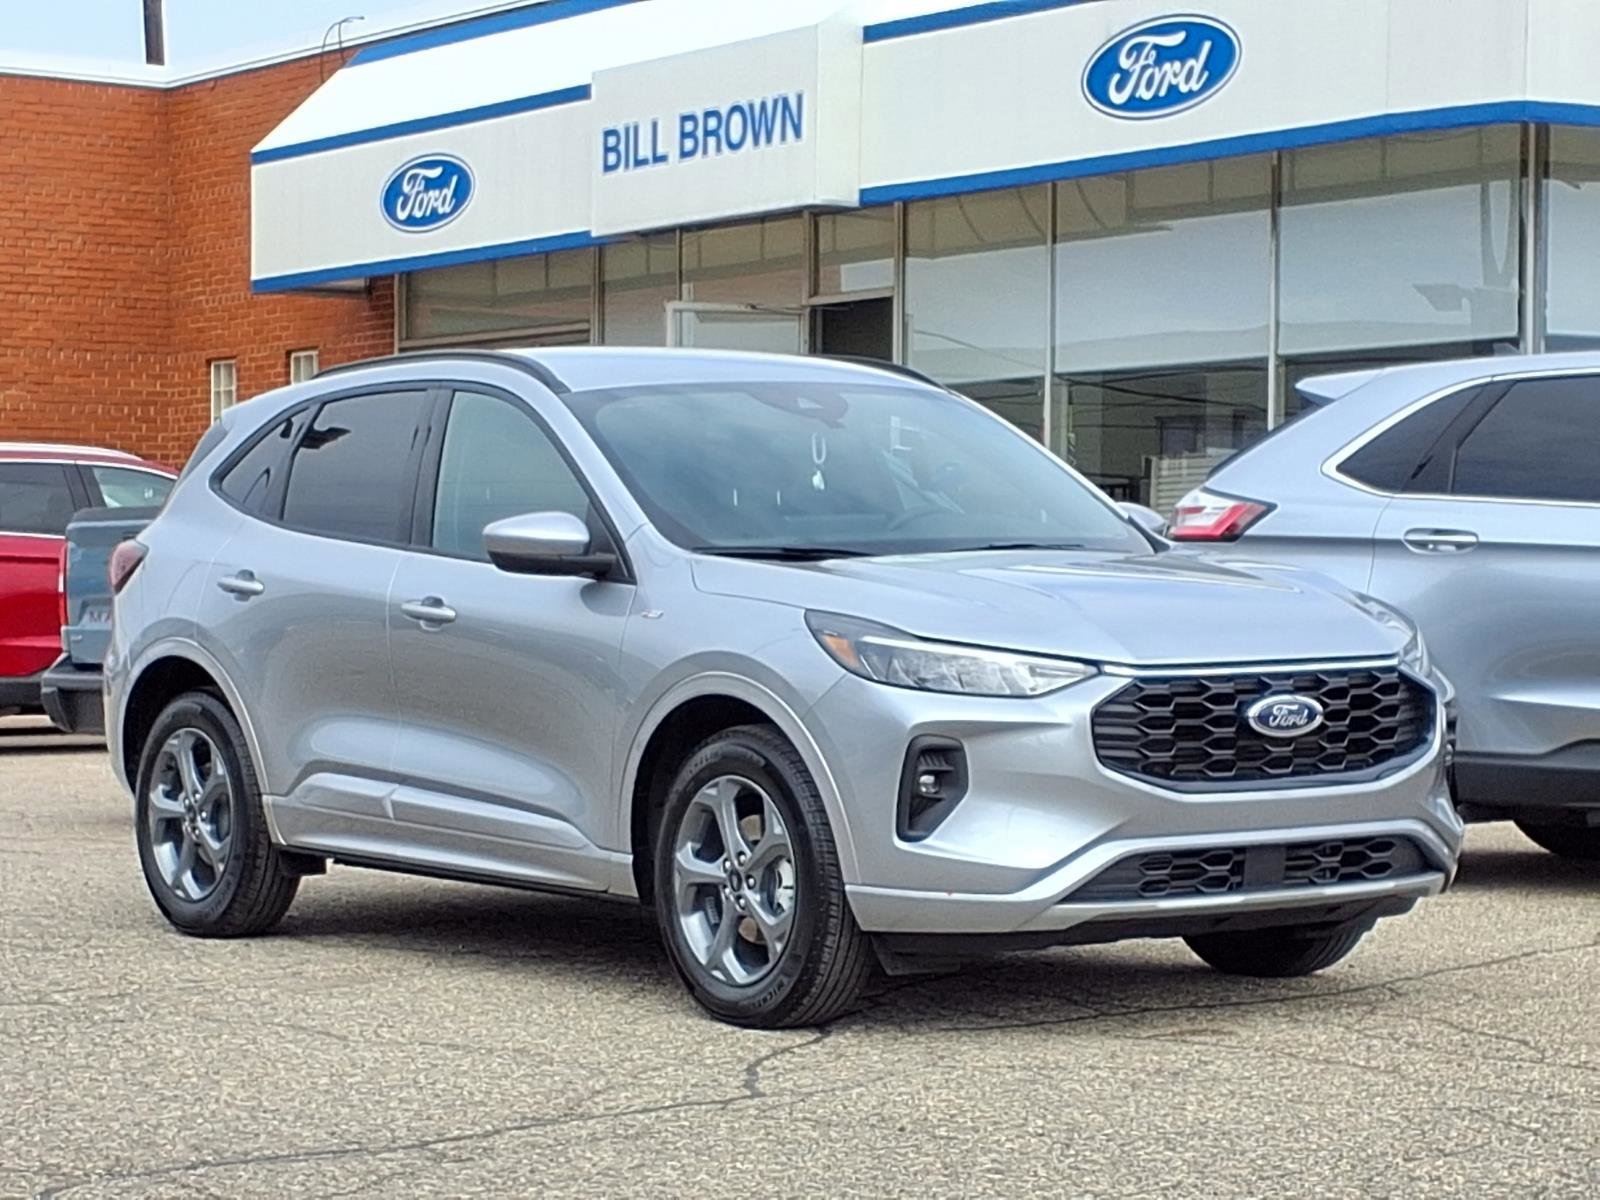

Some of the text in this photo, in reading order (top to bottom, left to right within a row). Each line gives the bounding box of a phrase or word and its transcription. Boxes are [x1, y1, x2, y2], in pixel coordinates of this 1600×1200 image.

[1108, 30, 1213, 105] Ford
[603, 92, 804, 173] BILL BROWN
[396, 166, 459, 221] Ford
[1268, 704, 1309, 727] Ford
